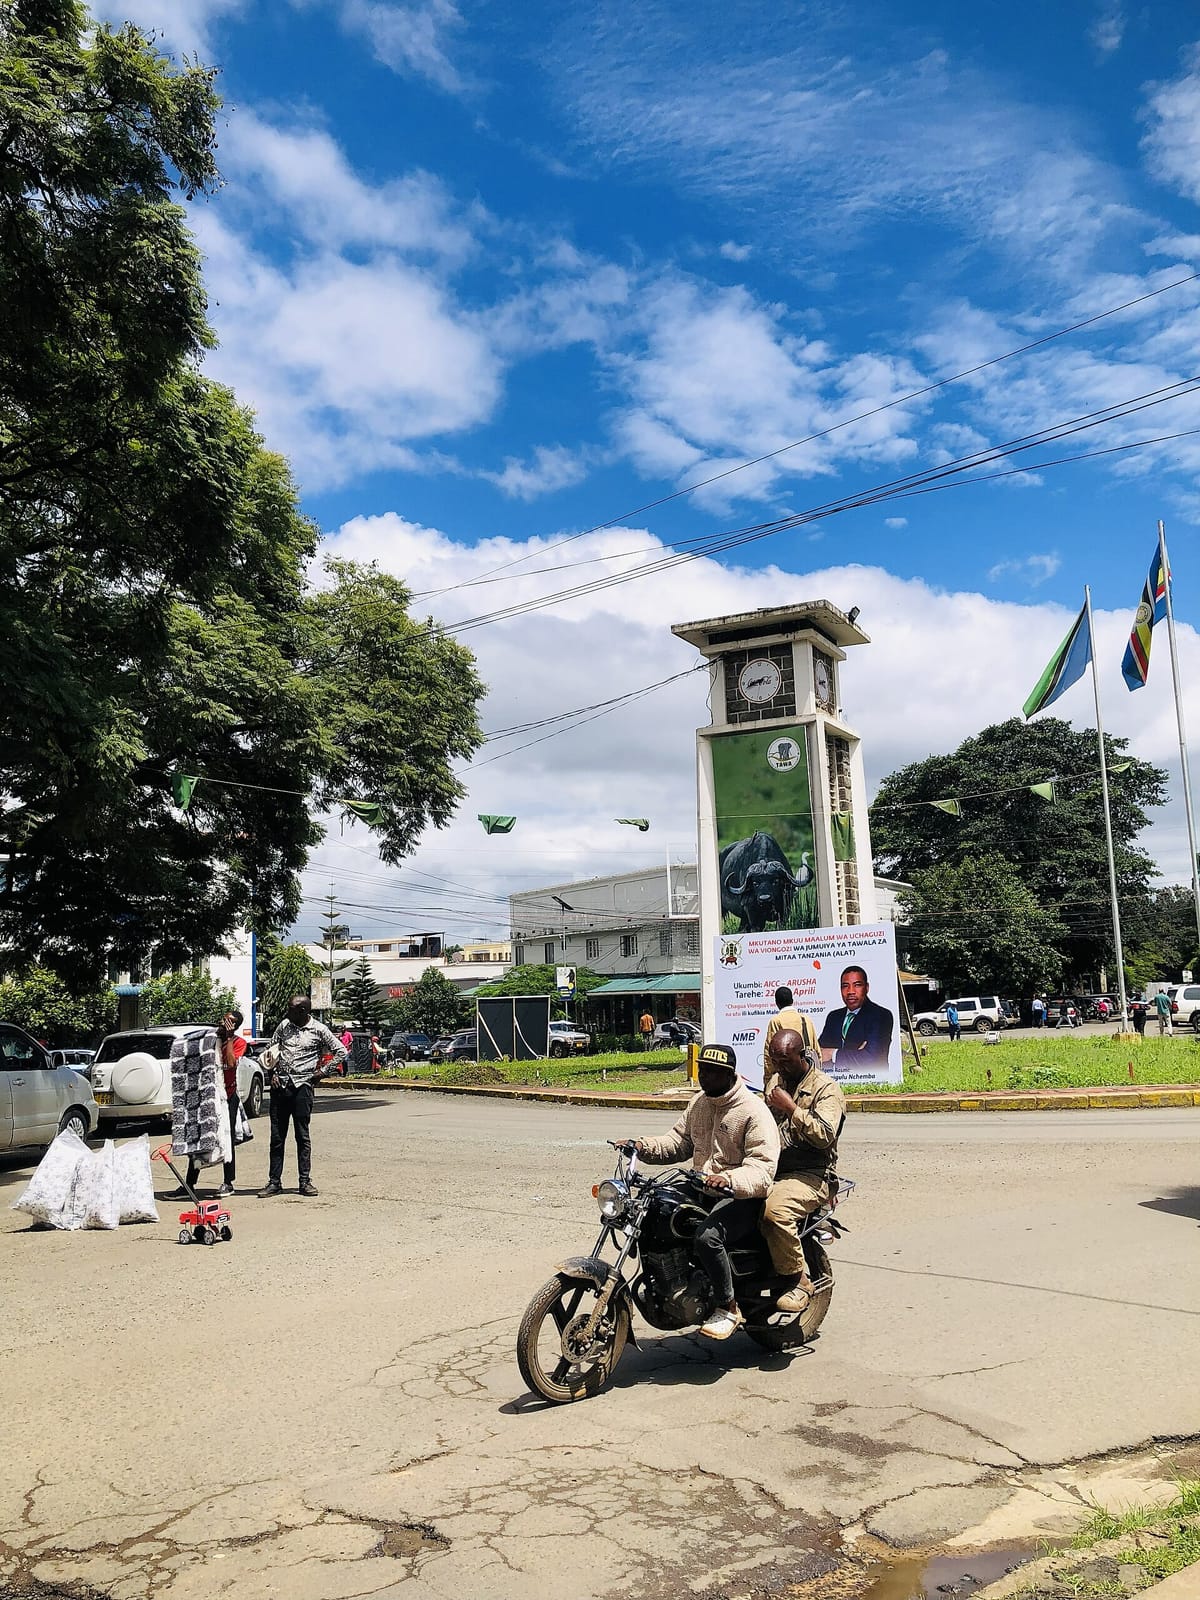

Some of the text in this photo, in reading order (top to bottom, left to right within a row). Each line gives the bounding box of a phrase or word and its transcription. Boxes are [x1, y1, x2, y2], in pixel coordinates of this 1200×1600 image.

[748, 939, 782, 947] MKUTANO
[804, 935, 835, 943] MAALUM
[849, 931, 885, 939] UCHAGUZI
[805, 942, 836, 951] JUMUIYA
[848, 939, 877, 947] TAWALA
[832, 949, 856, 957] (ALAT)
[733, 981, 763, 989] Ukumbi:
[787, 978, 817, 986] ARUSHA
[735, 990, 764, 999] Tarehe:
[793, 987, 816, 997] Aprili
[732, 1032, 756, 1041] NMB
[703, 1049, 728, 1063] CELTICS
